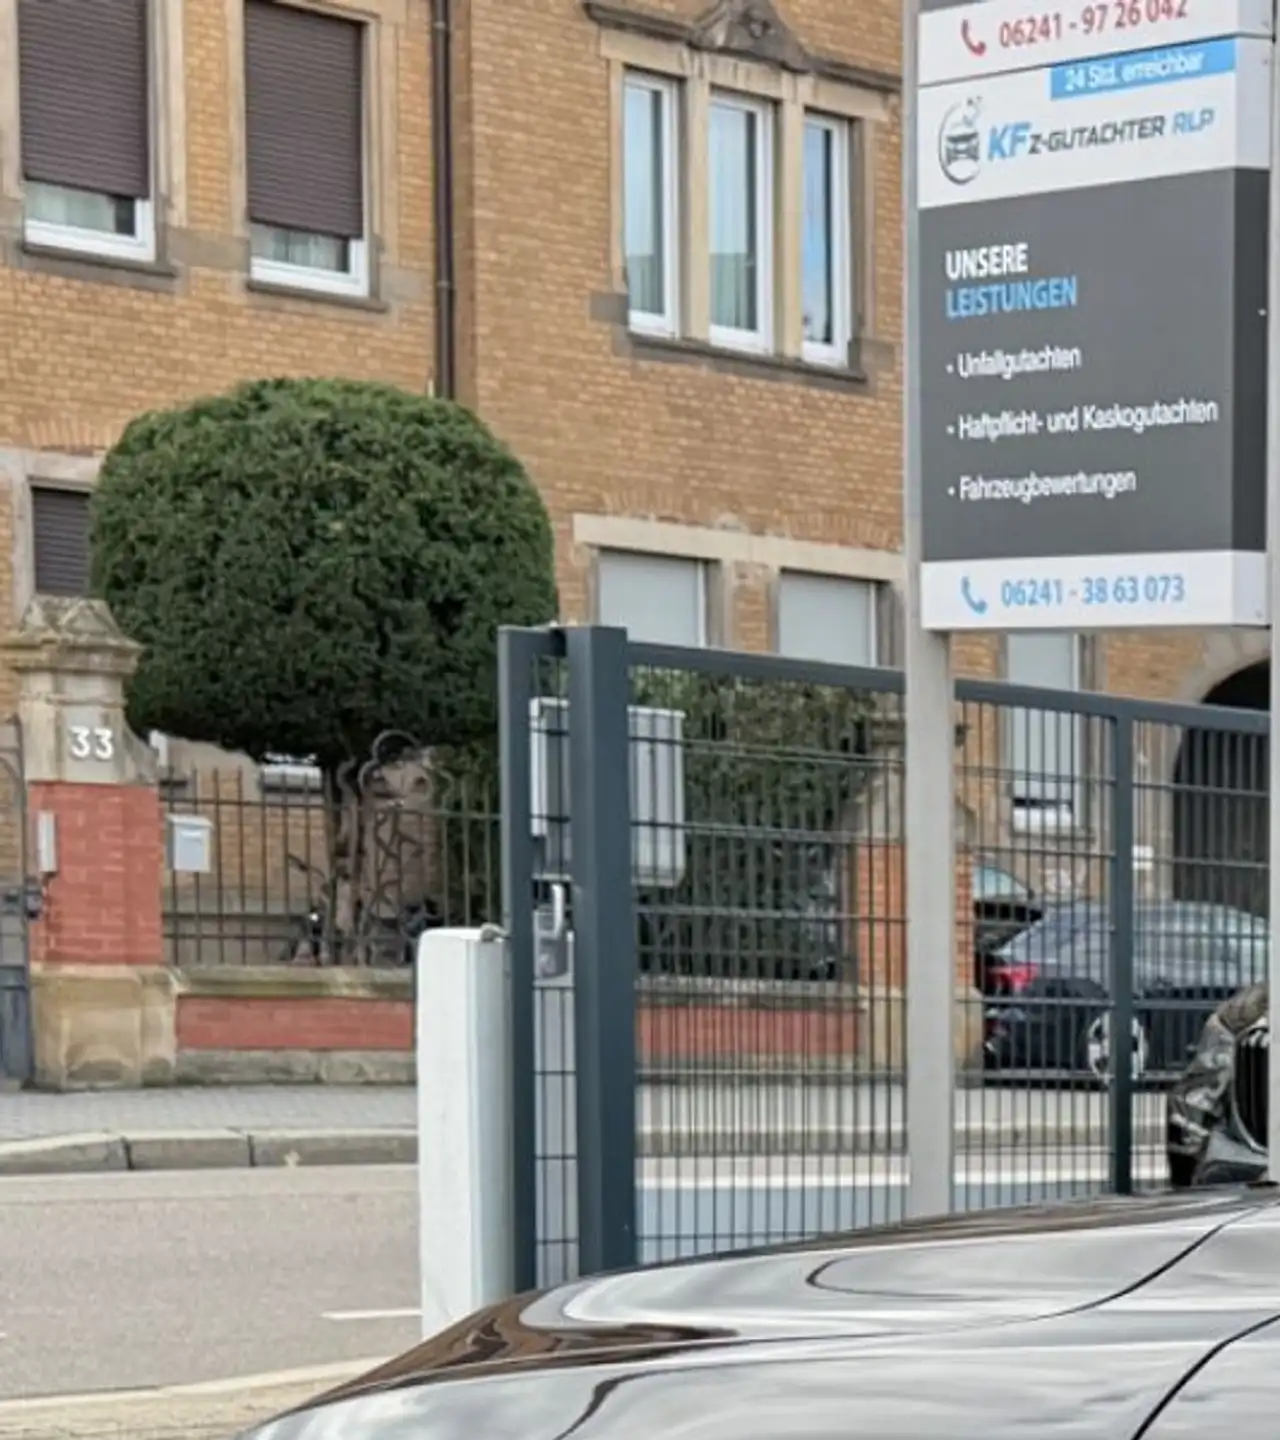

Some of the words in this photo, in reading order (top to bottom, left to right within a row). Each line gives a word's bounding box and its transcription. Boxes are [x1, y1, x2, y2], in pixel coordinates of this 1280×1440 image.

[999, 12, 1062, 48] 06241
[1081, 4, 1109, 35] 97
[1114, 0, 1142, 29] 26
[1146, 0, 1187, 23] 042
[1172, 107, 1216, 136] RLP
[945, 243, 1029, 279] UNSERE
[945, 276, 1078, 319] LEISTUNGEN
[958, 344, 1082, 380] Unfallgutachten
[958, 410, 1043, 441] Haftpflicht-
[1046, 406, 1079, 433] und
[1083, 398, 1219, 433] Kaskogutachten
[959, 469, 1137, 503] Fahrzeugbewertungen
[1001, 580, 1063, 608] 06241
[1082, 578, 1110, 605] 38
[1113, 577, 1140, 604] 63
[1144, 575, 1186, 601] 073
[69, 725, 114, 760] 33
